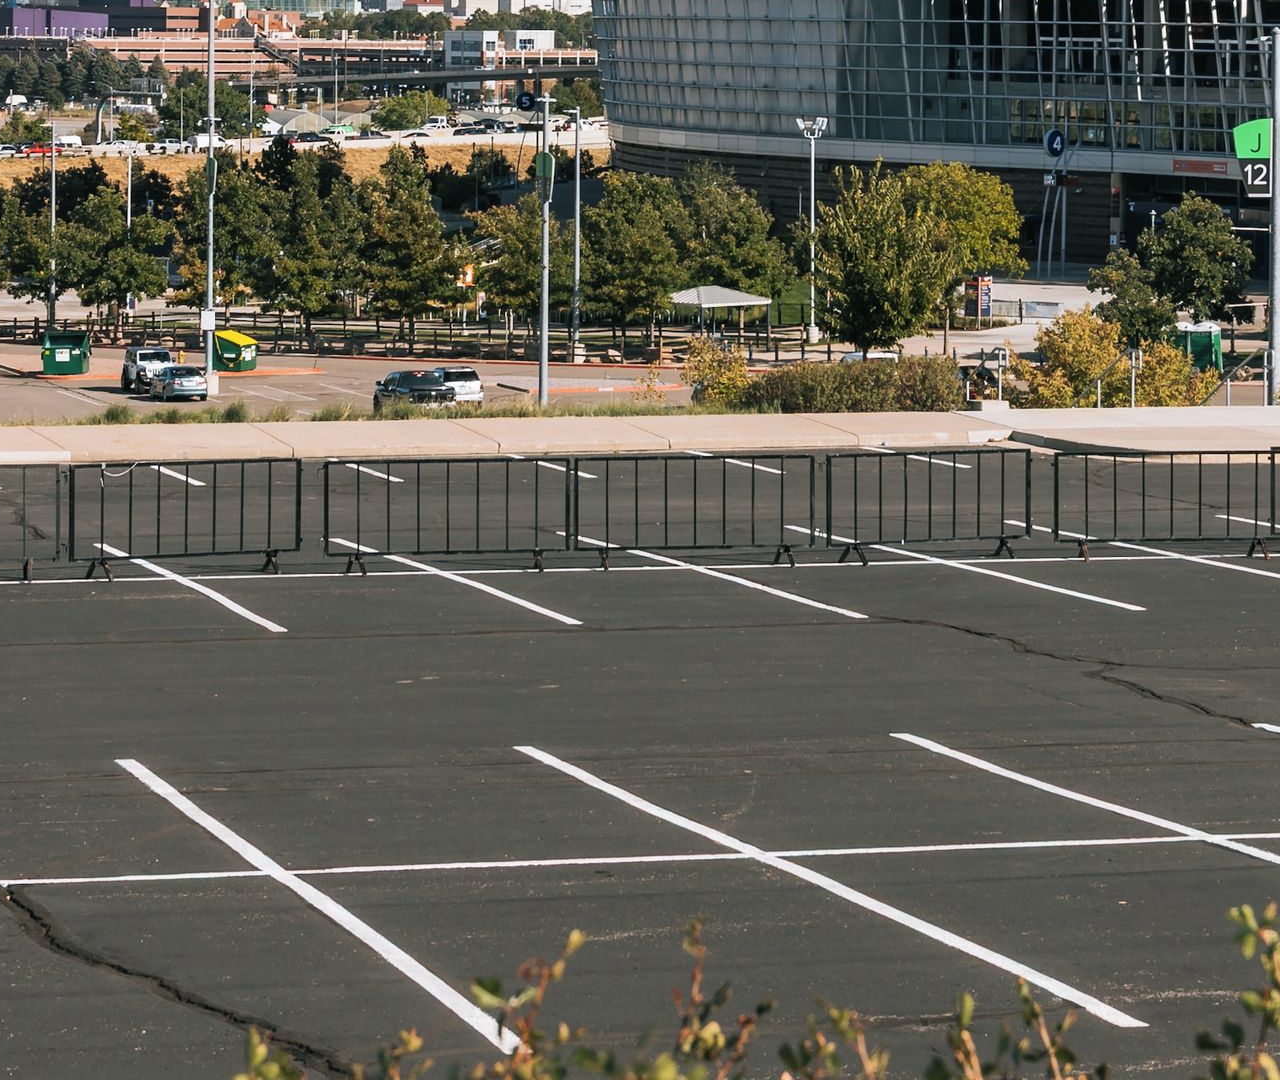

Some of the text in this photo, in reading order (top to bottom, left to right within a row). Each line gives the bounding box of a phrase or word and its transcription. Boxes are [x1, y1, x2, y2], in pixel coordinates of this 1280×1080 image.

[522, 96, 530, 107] 5
[1053, 136, 1062, 151] 4
[1250, 132, 1261, 153] J
[1244, 163, 1267, 185] 12
